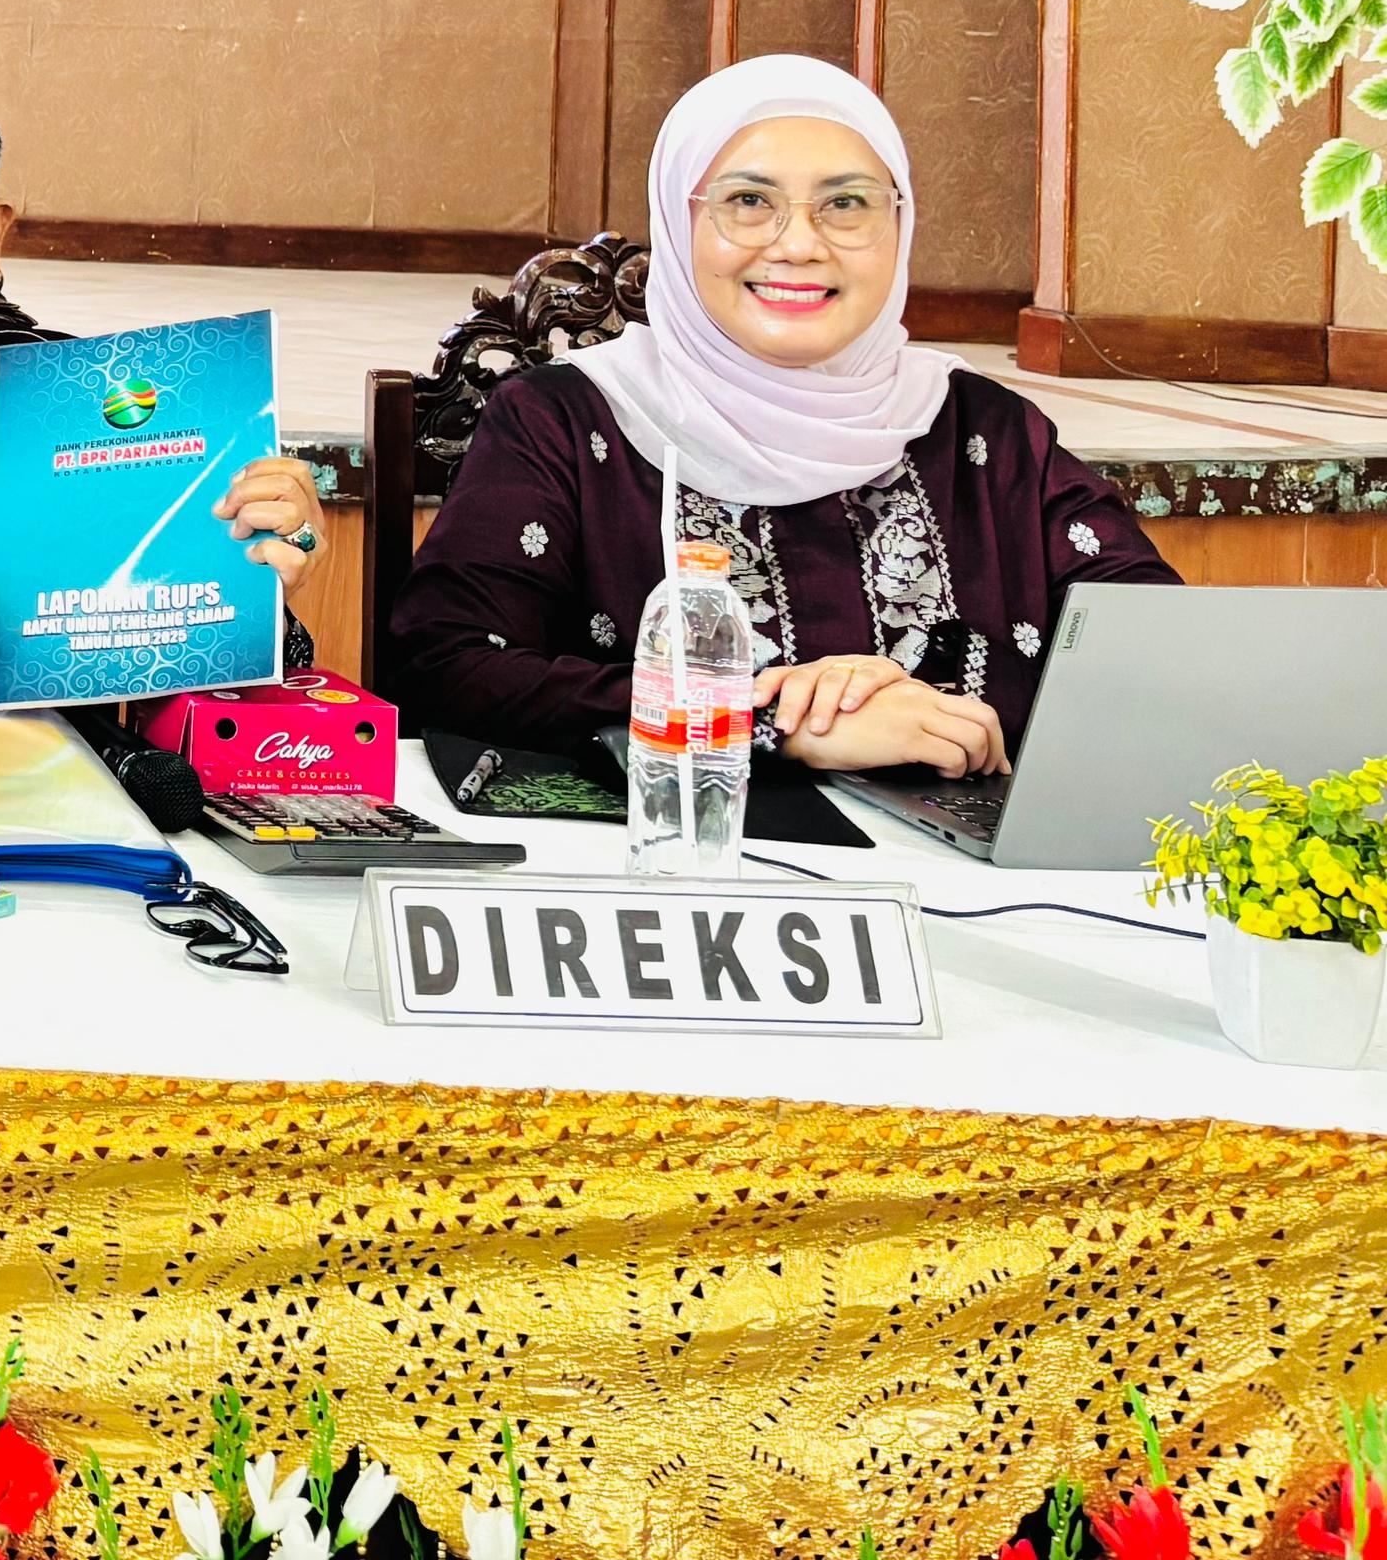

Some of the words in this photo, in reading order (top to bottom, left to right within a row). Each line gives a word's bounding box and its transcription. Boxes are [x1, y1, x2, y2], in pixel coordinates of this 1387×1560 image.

[55, 443, 81, 452] BANK
[84, 434, 161, 449] PEREKONOMIAN
[163, 428, 202, 440] RAKYAT
[55, 453, 74, 468] PT.
[79, 449, 109, 466] BPR
[113, 439, 205, 462] PARIANGAN
[54, 466, 90, 477] KOTA
[95, 456, 205, 473] BATUSANGKAR
[37, 587, 148, 617] LAPORAN
[154, 581, 221, 611] RUPS
[22, 617, 64, 637] RAPAT
[65, 614, 110, 634] UMUM
[111, 610, 185, 633] PEMEGANG
[185, 605, 236, 627] SAHAM
[1062, 611, 1081, 649] Lenovo
[69, 633, 112, 651] TAHUN
[113, 631, 151, 648] BUKU
[152, 628, 188, 646] 2025
[255, 731, 334, 770] Cahya
[237, 769, 272, 778] CAKE
[276, 770, 284, 779] &
[289, 770, 351, 780] COOKIES
[404, 905, 882, 1005] DIREKSI
